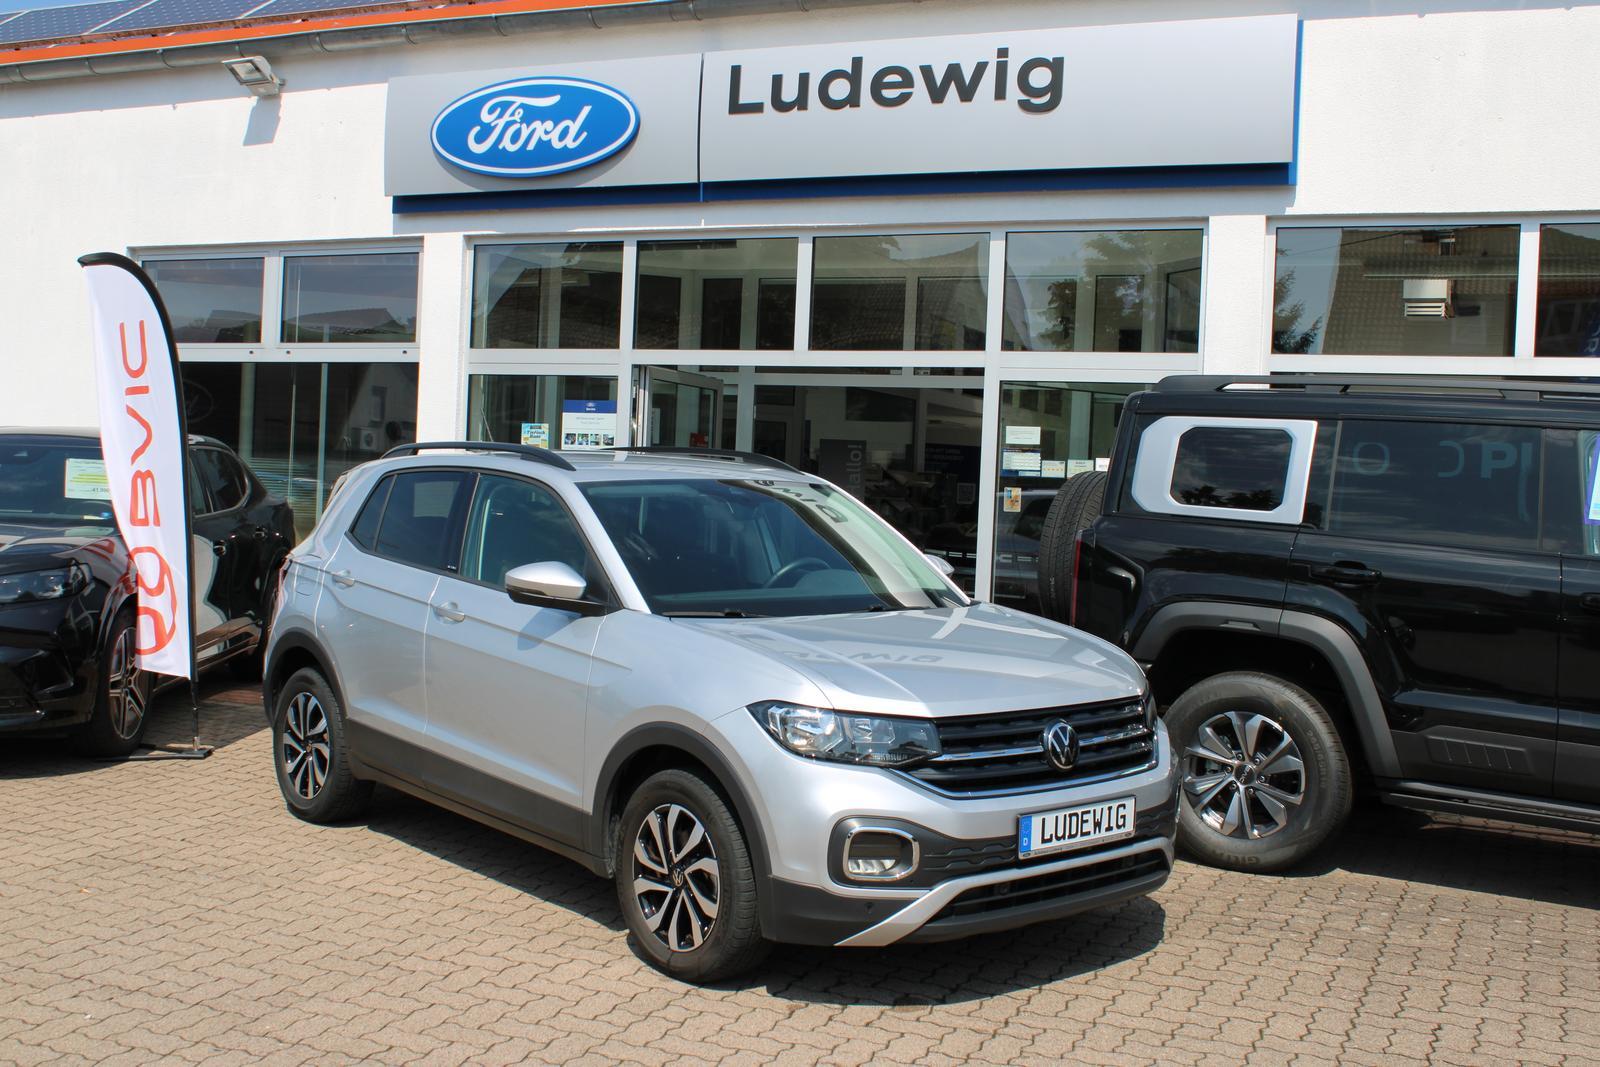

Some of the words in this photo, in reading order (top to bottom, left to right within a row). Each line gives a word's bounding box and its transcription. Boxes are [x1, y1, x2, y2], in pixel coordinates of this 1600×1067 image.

[728, 47, 1065, 114] Ludewig
[467, 94, 593, 154] Ford
[1041, 803, 1127, 844] LUDEWIG
